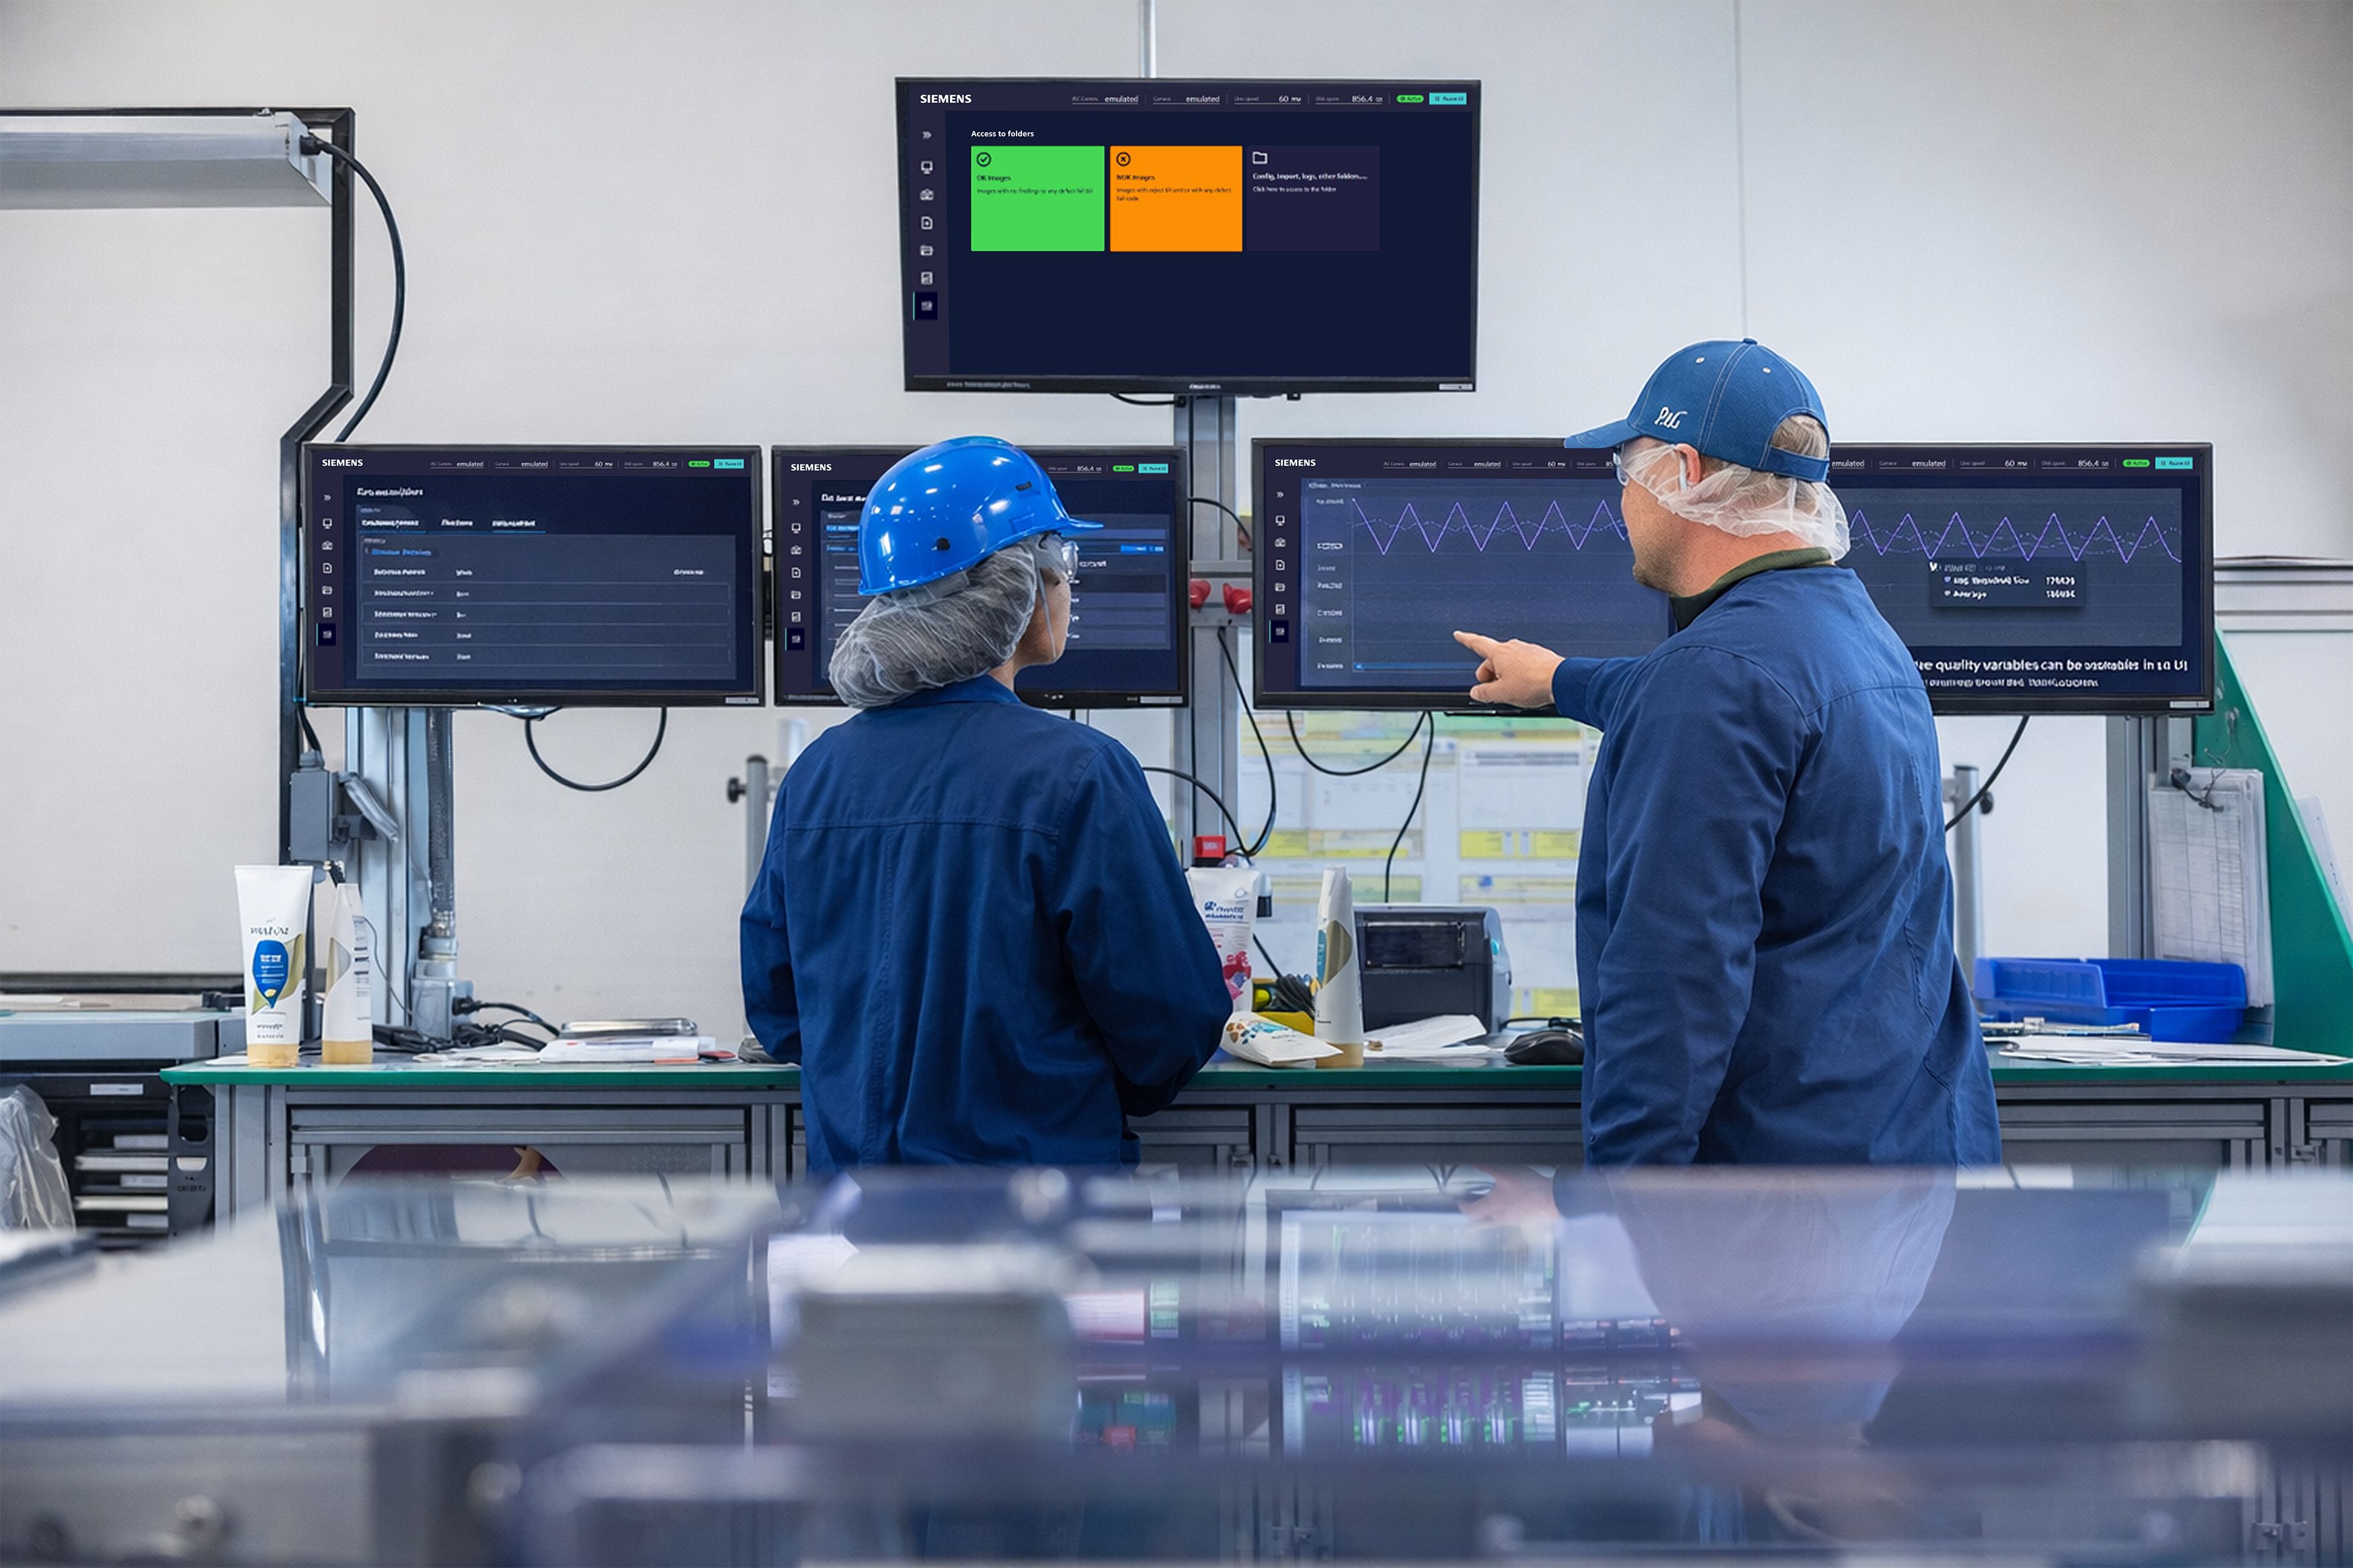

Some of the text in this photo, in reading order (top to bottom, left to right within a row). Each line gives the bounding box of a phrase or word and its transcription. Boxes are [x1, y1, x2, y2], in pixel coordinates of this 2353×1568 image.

[920, 94, 972, 104] SIEMENS
[1105, 95, 1139, 103] emulated
[1186, 95, 1220, 103] emulated
[1279, 95, 1289, 103] 60
[1133, 174, 1155, 182] Images
[322, 459, 363, 467] SIEMENS
[791, 463, 832, 471] SIEMENS
[1275, 459, 1316, 467] SIEMENS
[2040, 661, 2063, 670] can
